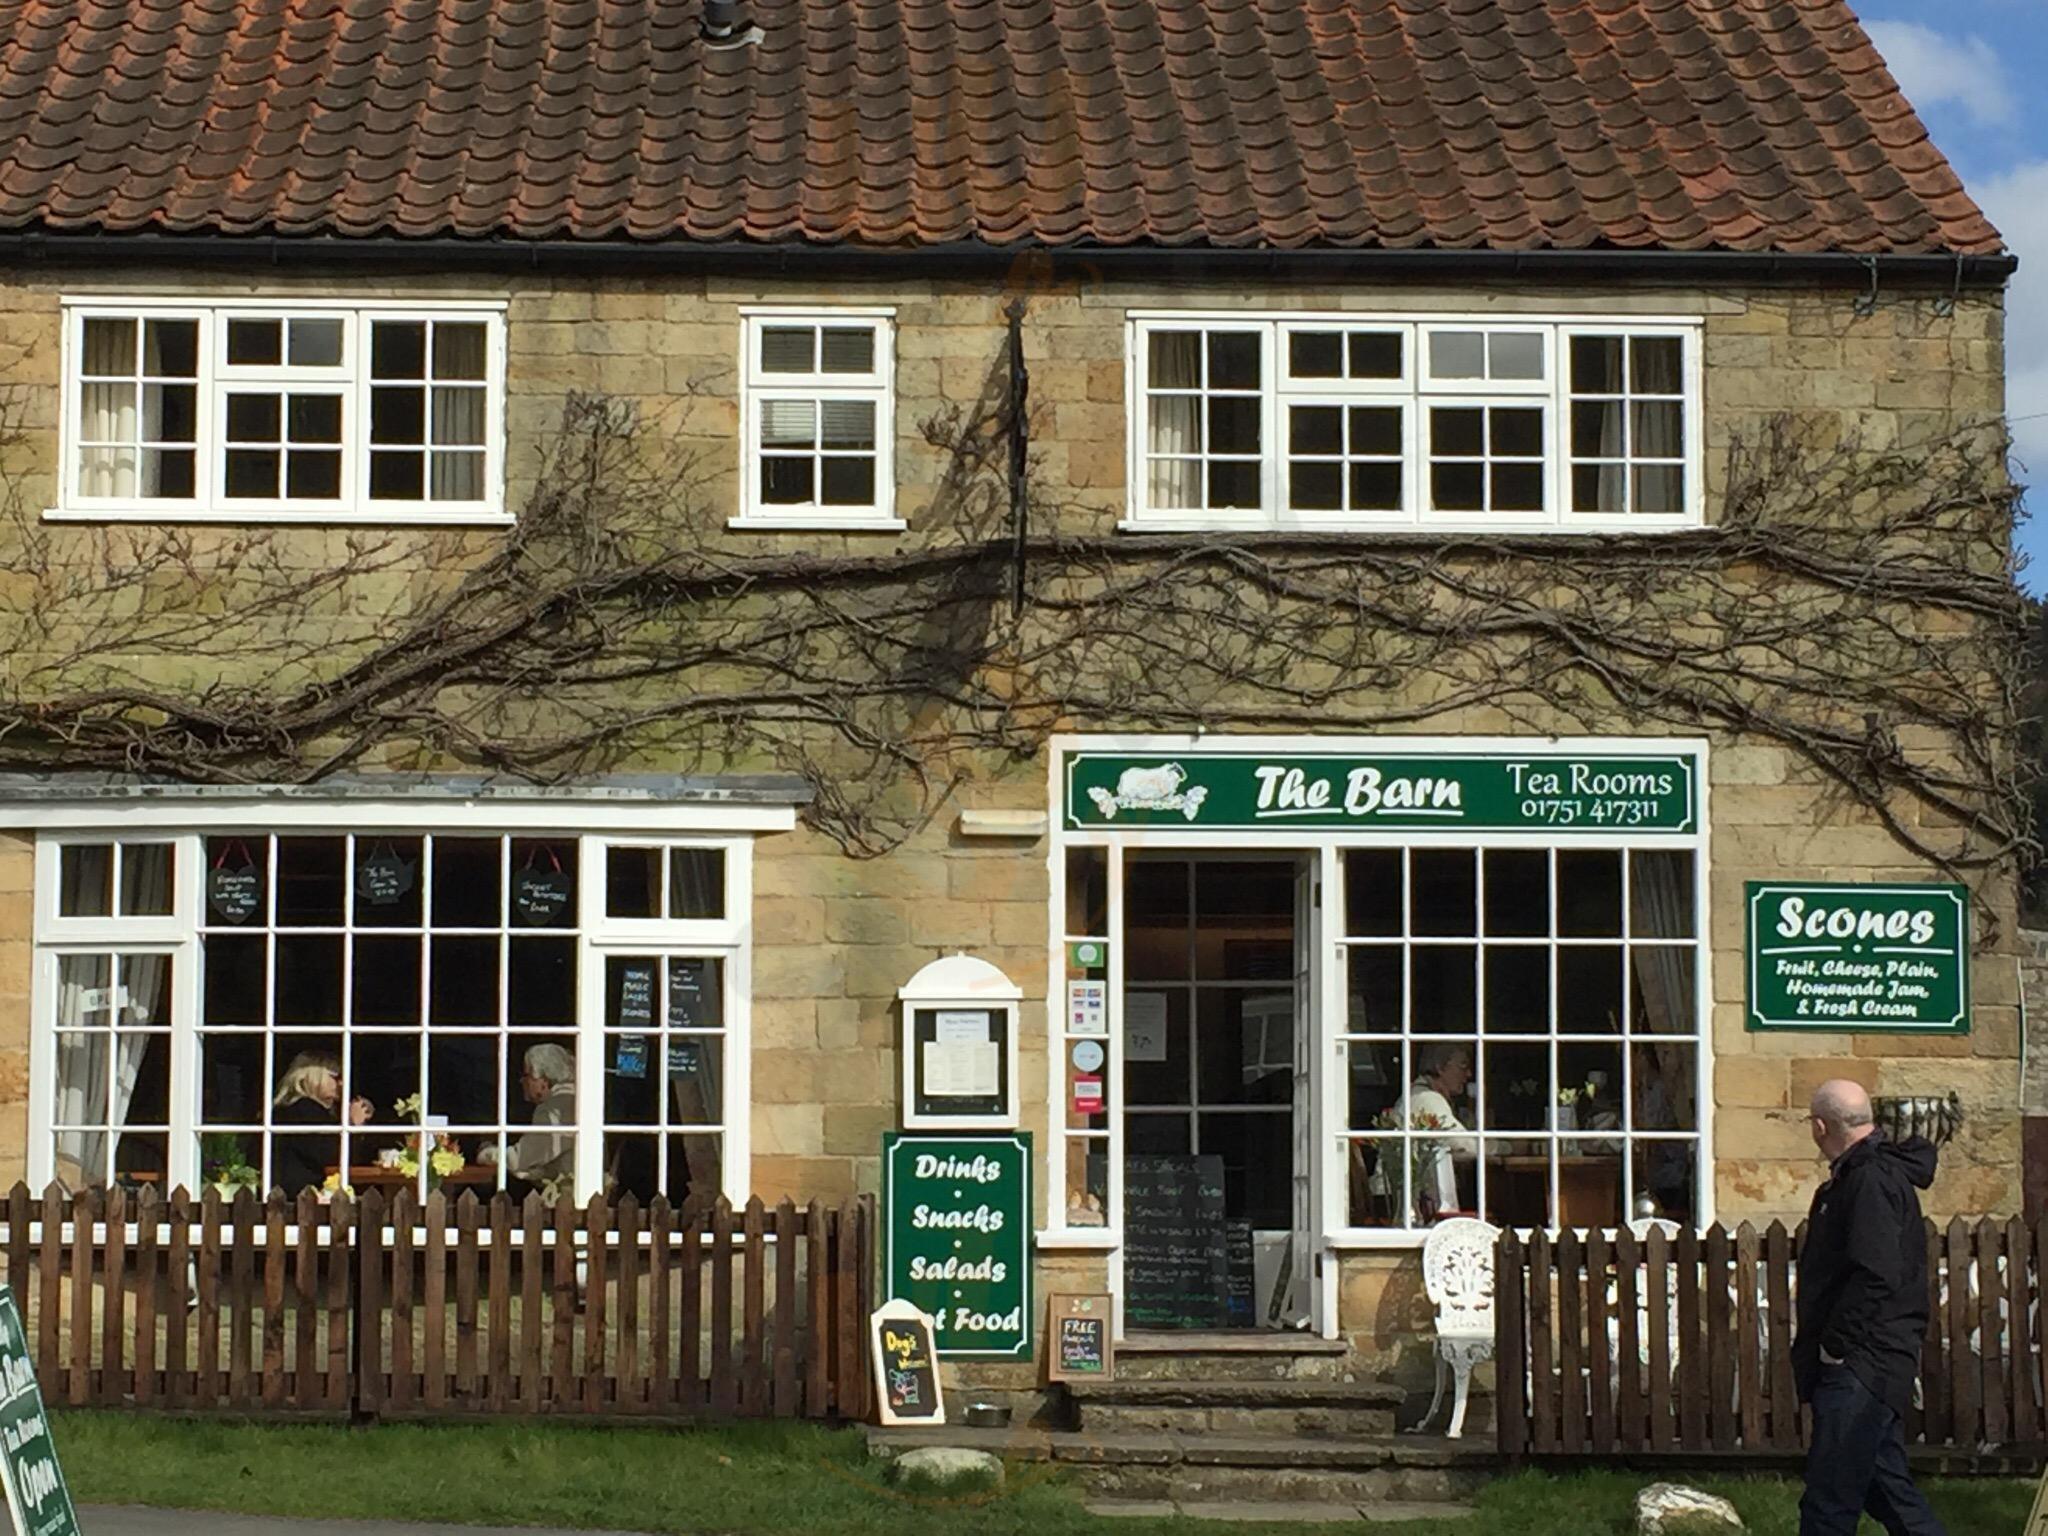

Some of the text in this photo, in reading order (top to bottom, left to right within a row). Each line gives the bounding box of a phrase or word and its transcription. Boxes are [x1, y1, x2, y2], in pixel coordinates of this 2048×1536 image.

[1255, 766, 1463, 816] The Barn
[1506, 763, 1673, 797] Tea Rooms
[1521, 799, 1658, 824] 01751 417311
[1776, 896, 1935, 944] Scones
[1775, 959, 1939, 980] Fruit, Cheese, Plain,
[1785, 979, 1930, 1000] Homemade Jam,
[1796, 998, 1918, 1019] & Fresh Cream
[915, 1154, 1001, 1184] Drinks
[912, 1204, 1004, 1233] Snacks
[909, 1255, 1006, 1283] Salads
[953, 1306, 1020, 1332] Food
[1064, 1319, 1097, 1334] FREE
[18, 1455, 60, 1516] Open
